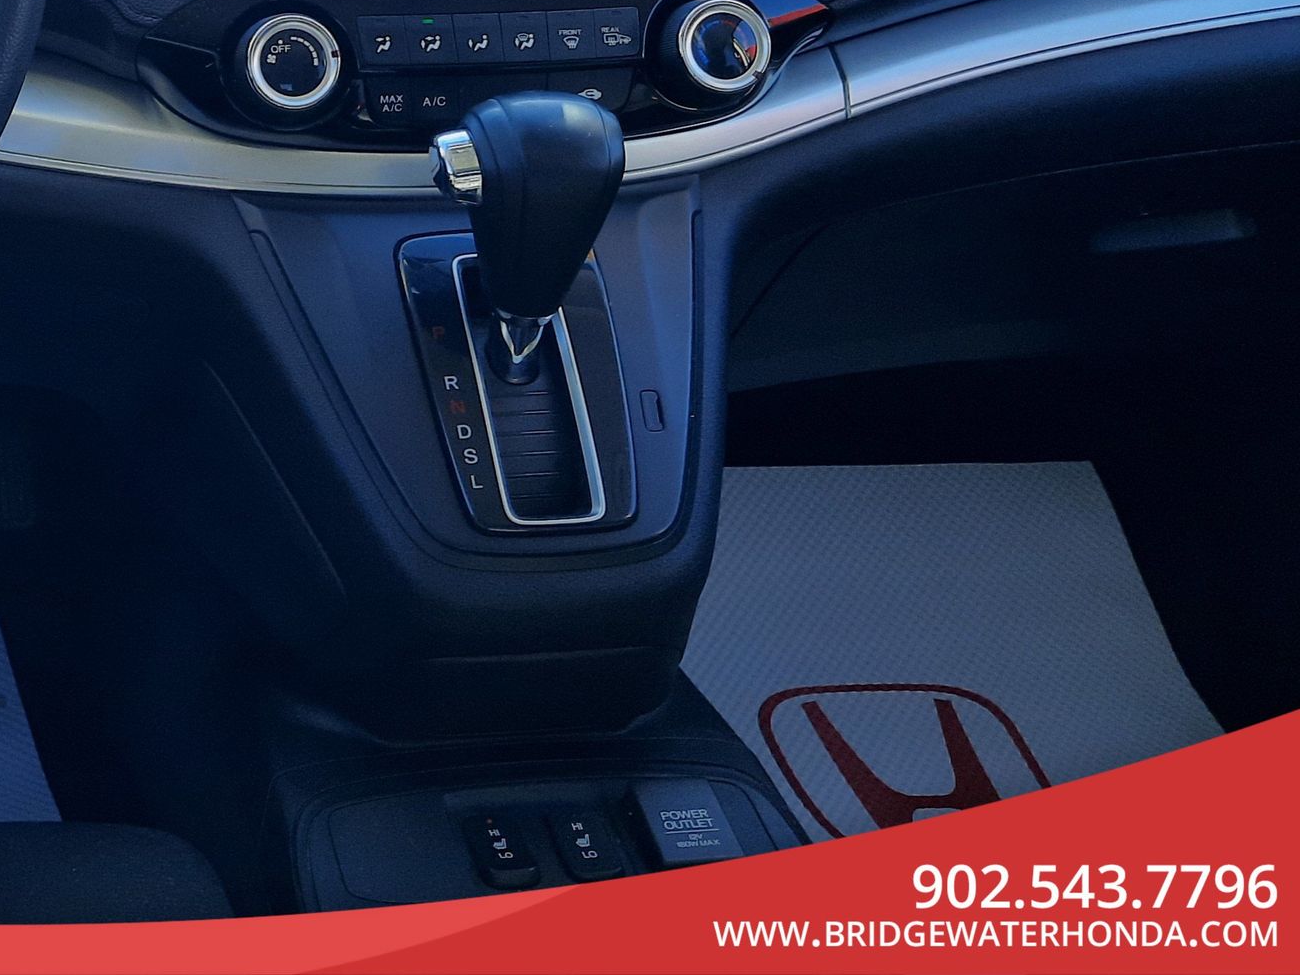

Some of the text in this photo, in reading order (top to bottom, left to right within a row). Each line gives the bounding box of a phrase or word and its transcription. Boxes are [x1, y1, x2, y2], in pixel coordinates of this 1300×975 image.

[270, 44, 292, 54] OFF
[380, 95, 403, 104] MAX
[422, 96, 446, 107] A/C
[382, 103, 402, 113] A/C
[444, 376, 459, 390] R
[457, 425, 471, 439] D
[463, 448, 479, 465] S
[470, 475, 484, 489] L
[660, 809, 709, 821] POWER
[572, 822, 584, 831] HI
[663, 818, 714, 830] OUTLET
[488, 829, 500, 837] HI
[582, 850, 598, 859] LO
